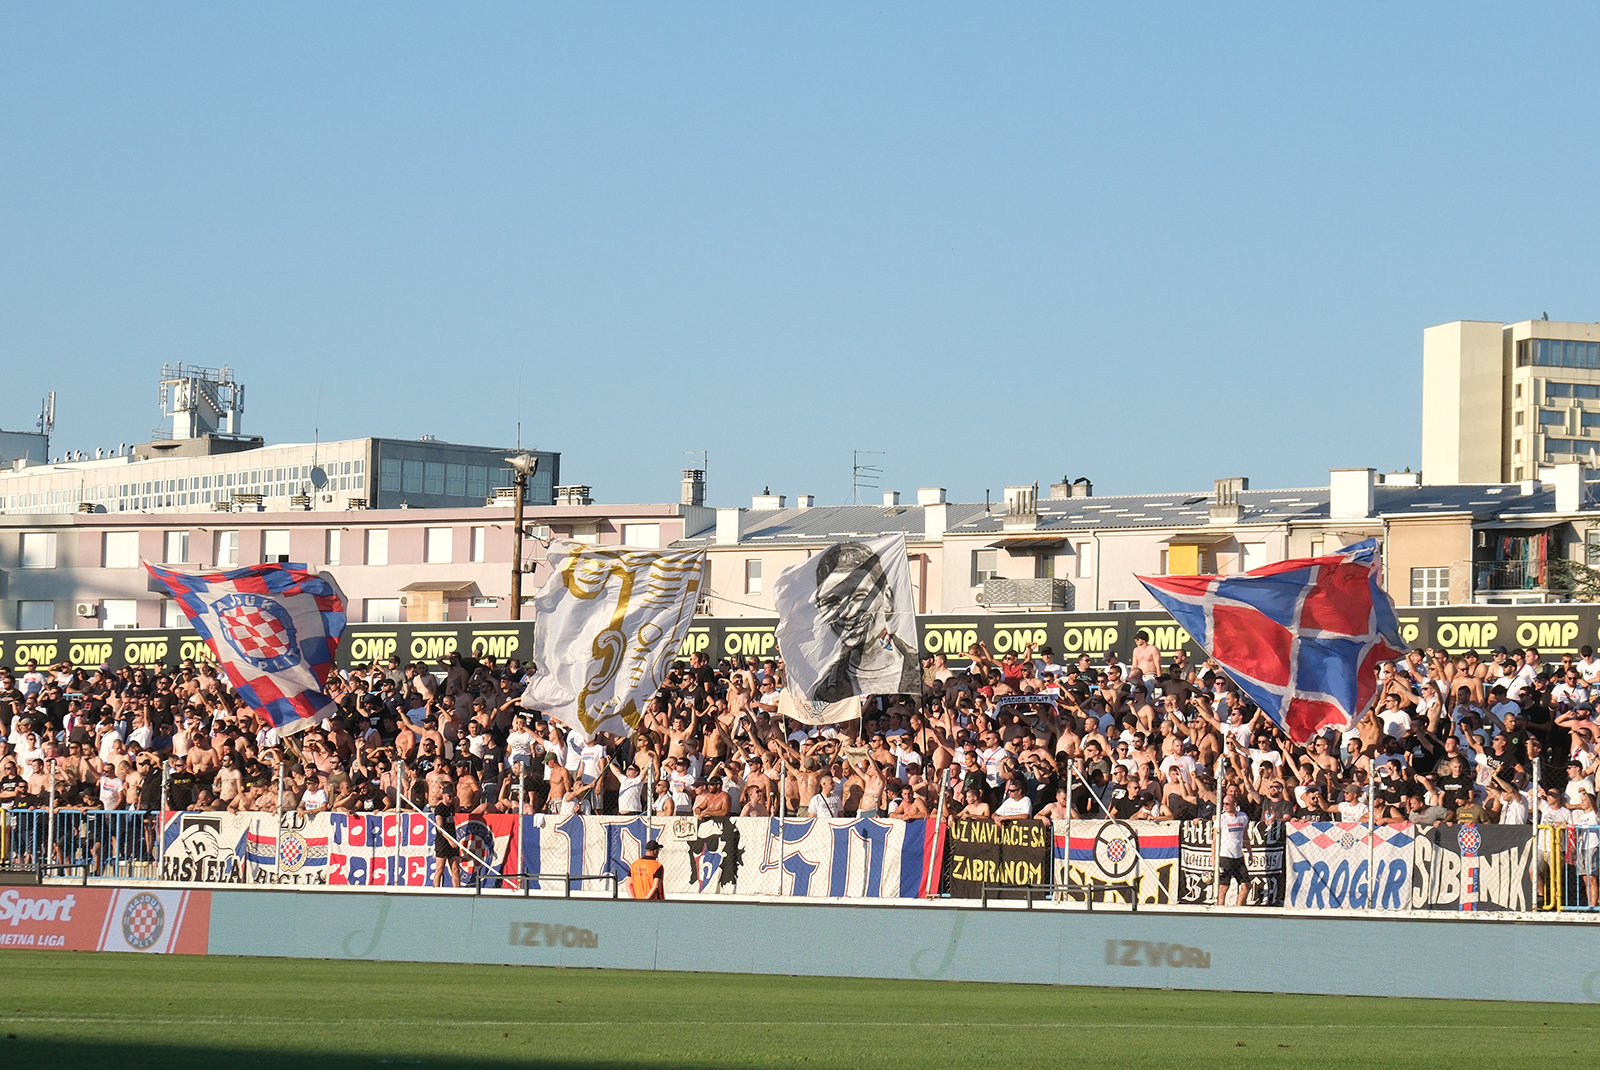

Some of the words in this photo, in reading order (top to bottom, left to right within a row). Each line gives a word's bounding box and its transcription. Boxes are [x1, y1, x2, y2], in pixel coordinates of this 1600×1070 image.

[678, 633, 710, 655] MP
[724, 632, 775, 655] OMP
[924, 629, 978, 653] OMP
[993, 629, 1047, 653] OMP
[1063, 627, 1118, 651] OMP
[1436, 622, 1498, 648] OMP
[1515, 621, 1579, 647] OMP
[15, 644, 58, 665] OMP
[69, 643, 113, 665] OMP
[124, 642, 168, 664] OMP
[350, 638, 397, 660] OMP
[410, 637, 458, 659] OMP
[471, 636, 519, 658] OMP
[952, 821, 969, 842] UZ
[1030, 826, 1045, 848] SA
[952, 855, 1042, 886] ZABRANOM
[1412, 824, 1535, 912] ŠIBENIK
[1292, 858, 1408, 910] TROGIR
[0, 889, 76, 926] Sport
[128, 895, 161, 912] HAJDUK
[37, 935, 66, 947] LIGA
[127, 934, 155, 948] SPLIT
